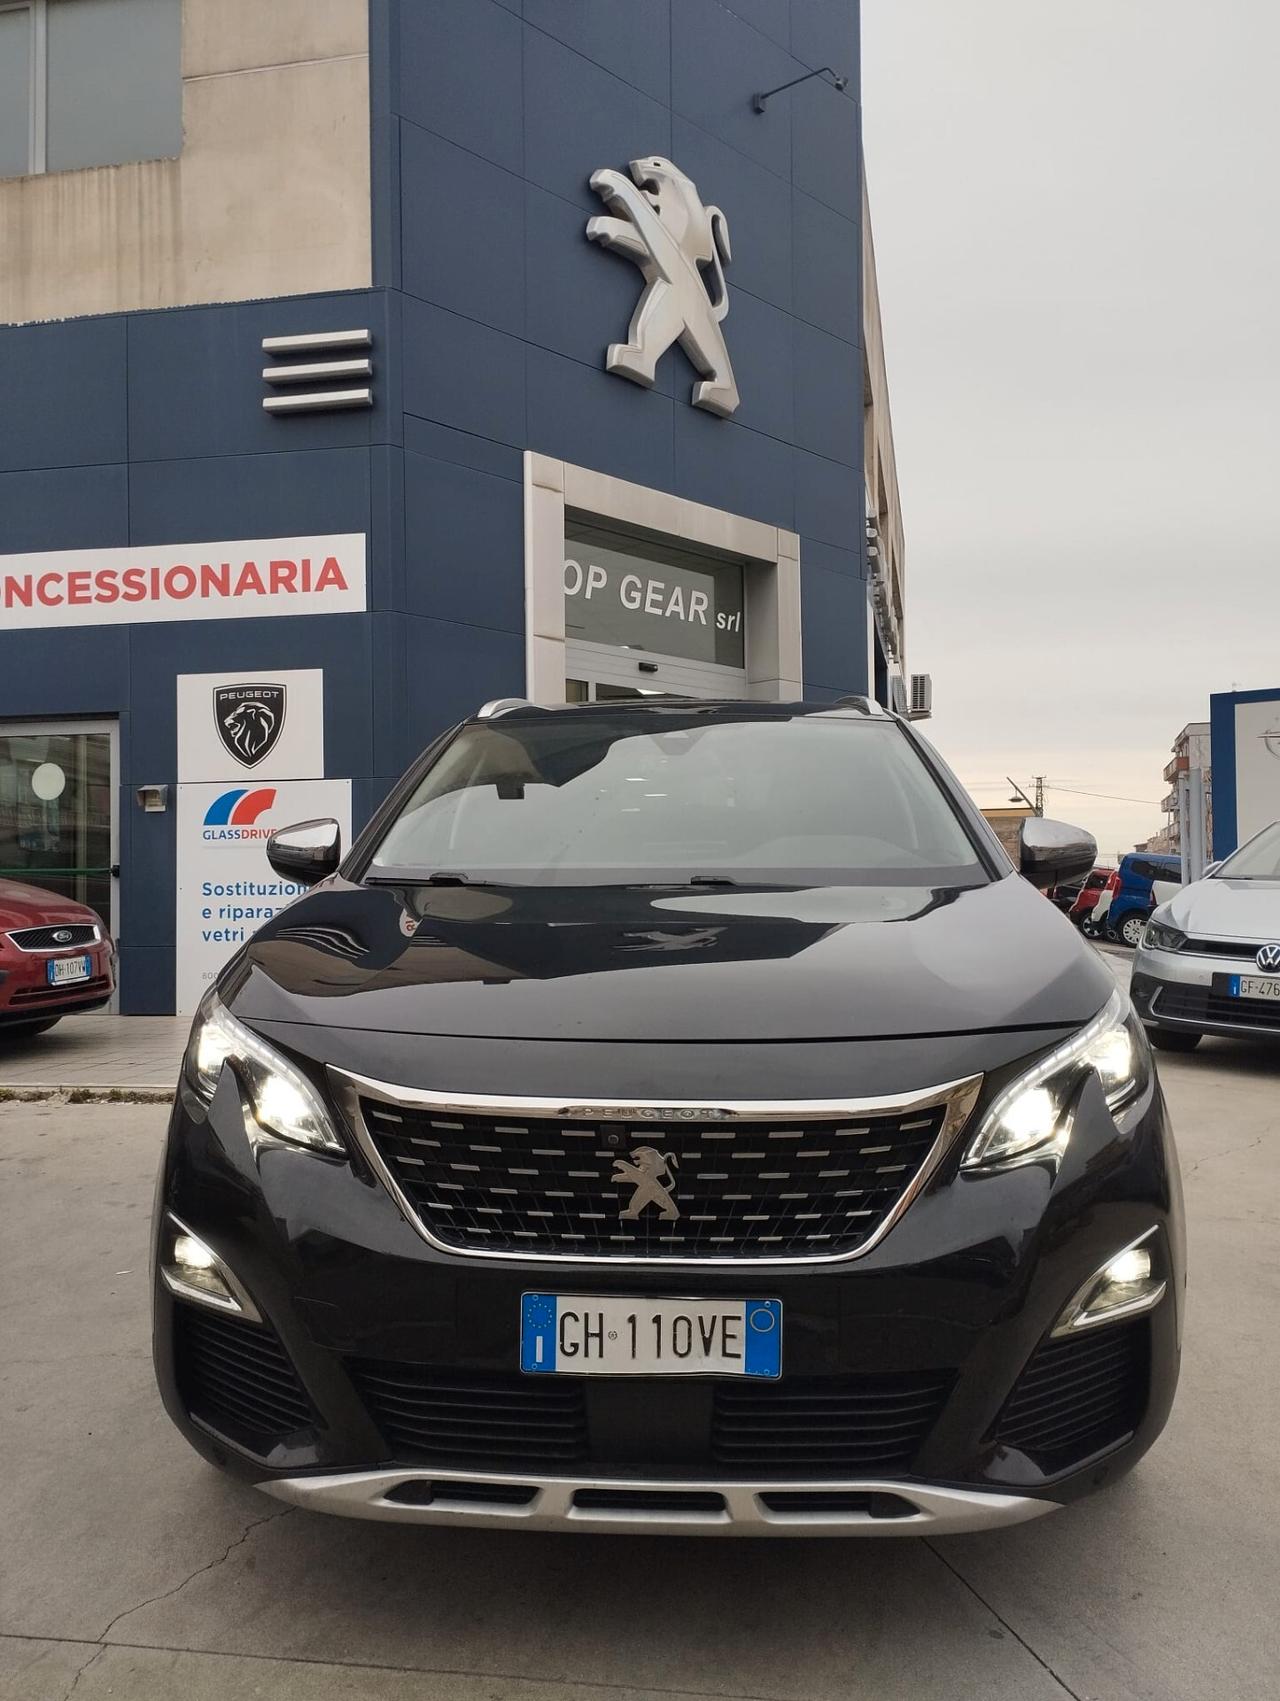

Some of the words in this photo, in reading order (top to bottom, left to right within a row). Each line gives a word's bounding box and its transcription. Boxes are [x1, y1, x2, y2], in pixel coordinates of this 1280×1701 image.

[0, 557, 348, 608] NCESSIONARIA
[620, 574, 709, 625] GEAR
[716, 611, 741, 633] srl
[219, 690, 280, 700] PEUGEOT
[202, 908, 212, 919] e
[219, 904, 282, 922] ripara
[202, 927, 245, 942] vetri
[1240, 980, 1254, 994] GF
[582, 1106, 714, 1119] PEUGEOT
[560, 1311, 604, 1359] GH
[627, 1313, 742, 1360] 110VE
